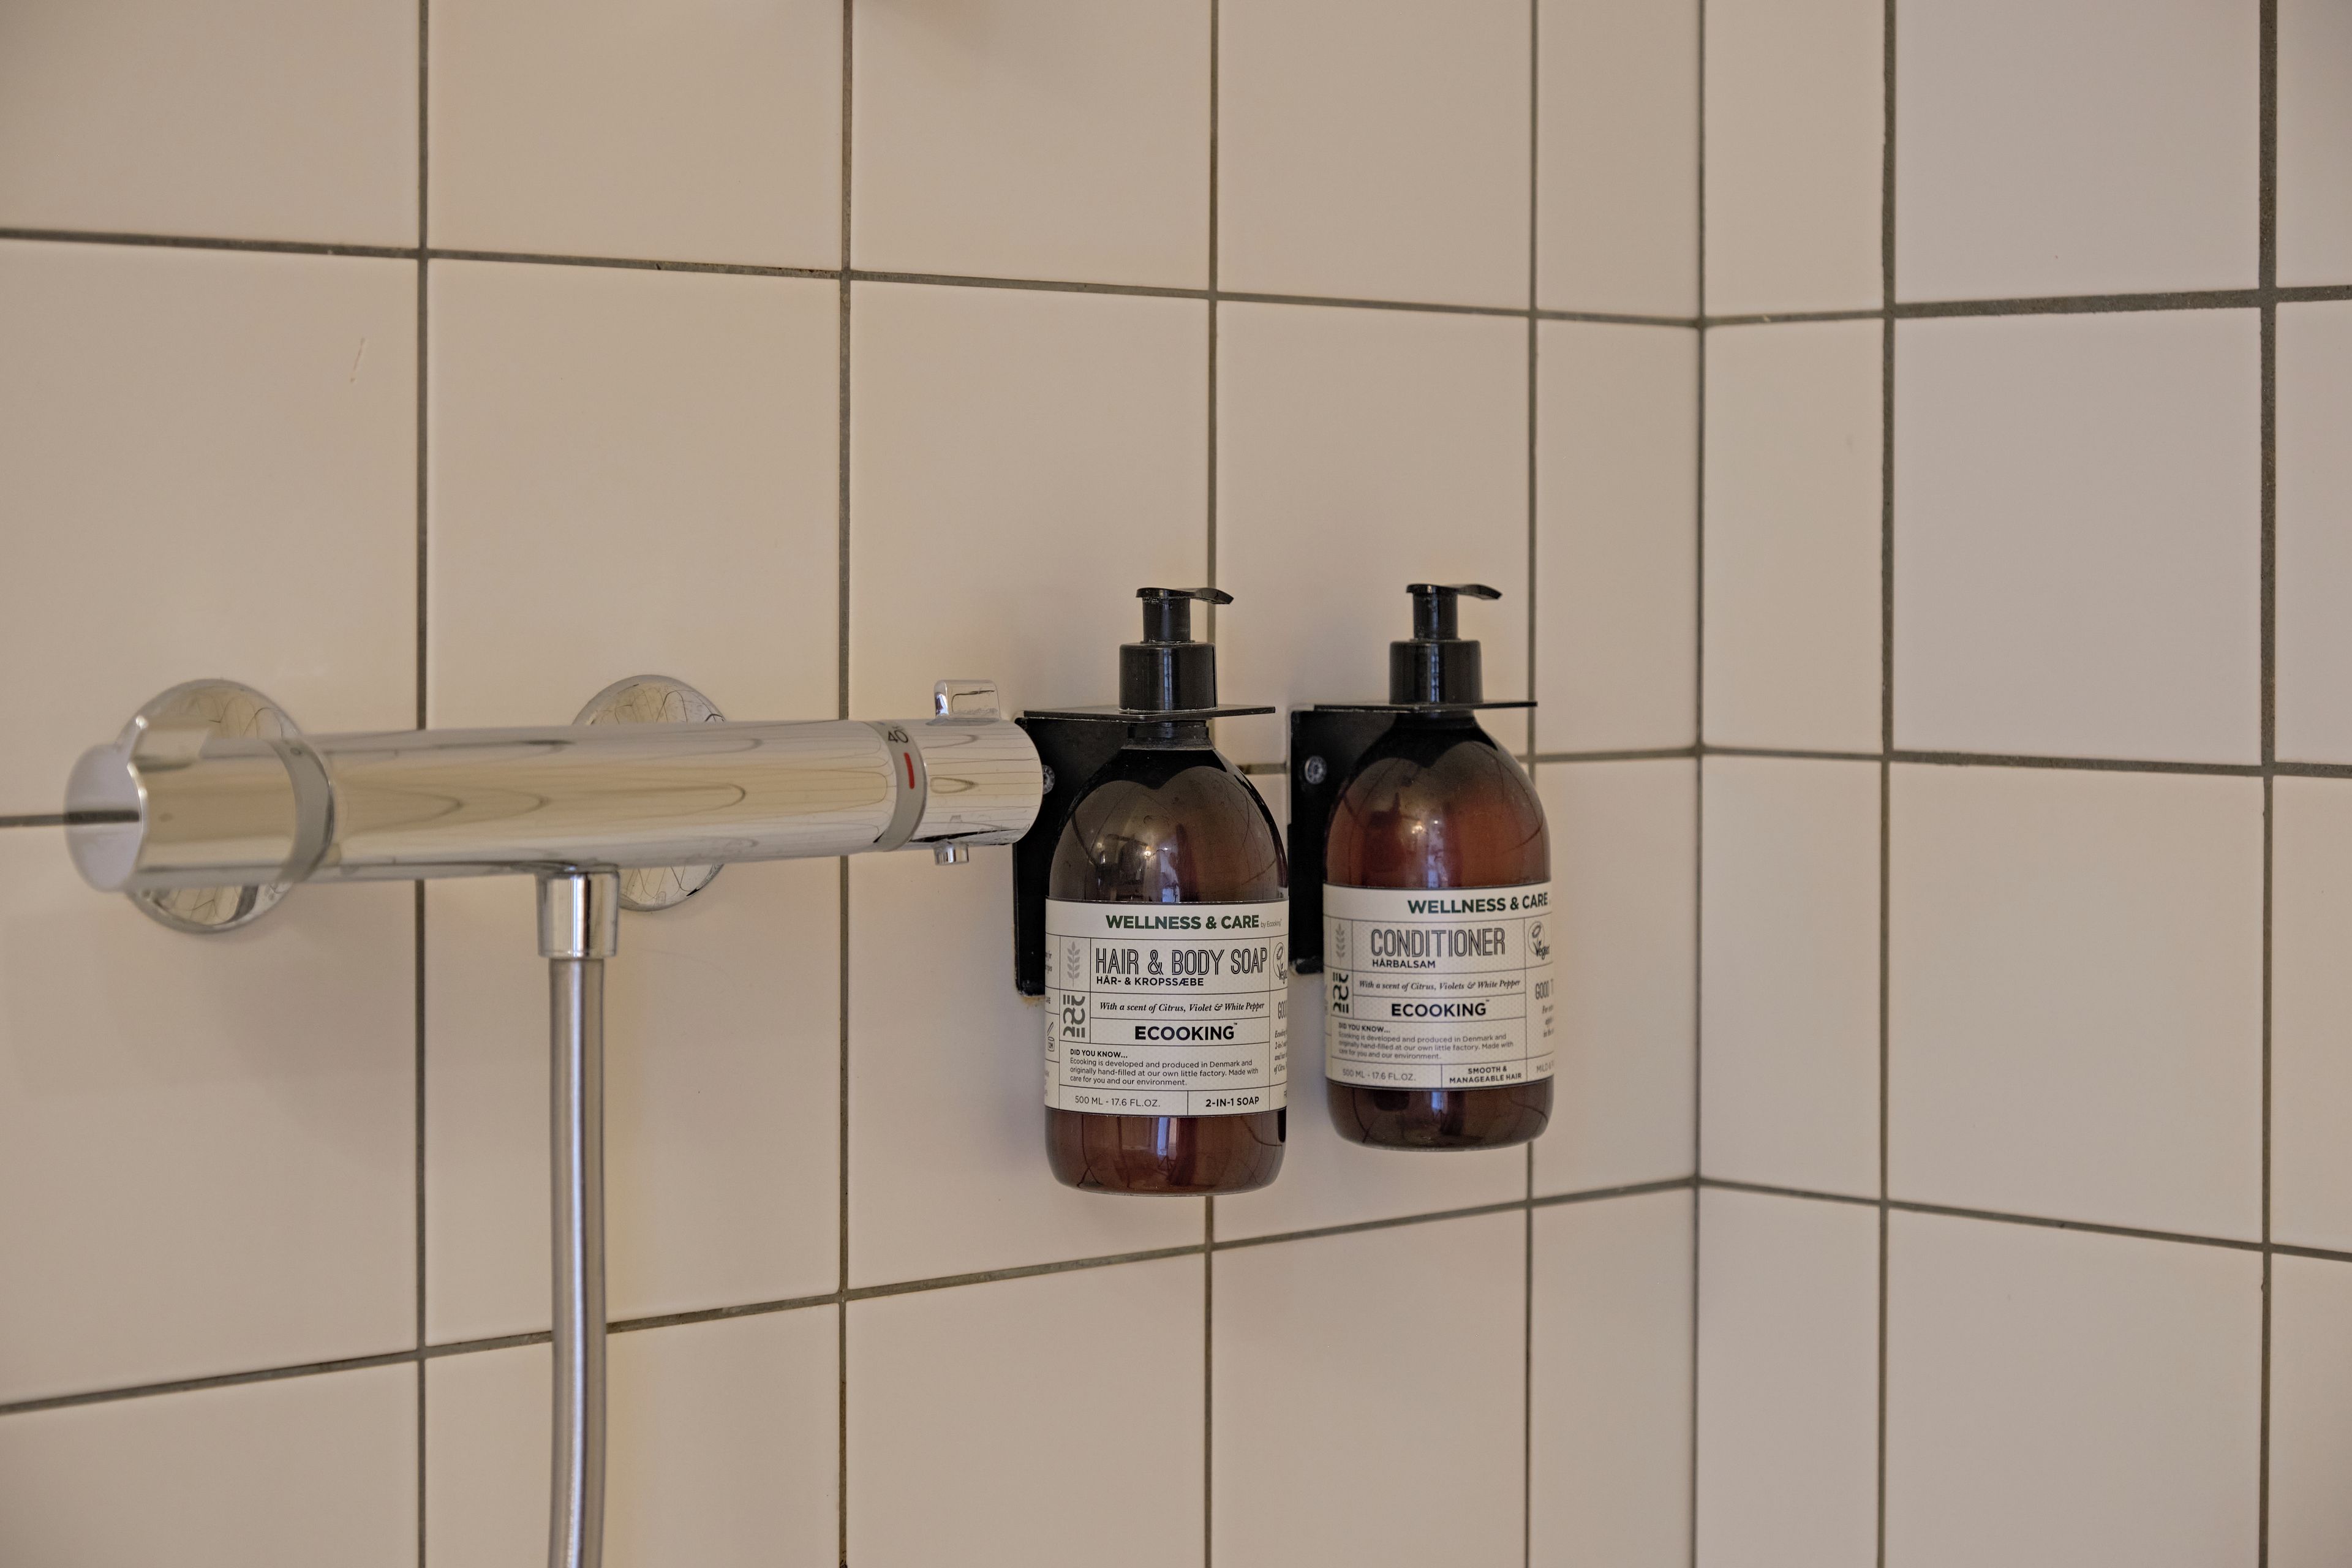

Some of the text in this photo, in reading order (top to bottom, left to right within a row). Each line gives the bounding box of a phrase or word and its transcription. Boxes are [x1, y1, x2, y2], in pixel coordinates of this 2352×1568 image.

[888, 729, 908, 744] 40
[1408, 892, 1548, 914] WELLNESS & CARE
[1106, 914, 1202, 930] WELLNESS
[1205, 916, 1217, 929] &
[1221, 914, 1259, 929] CARE
[1371, 928, 1506, 957] CONDITIONER
[1096, 948, 1268, 976] HAIR & BODY SOAP
[1372, 958, 1436, 968] HÅRBALSAM
[1096, 974, 1204, 986] HÅR- & KROPSSÆBE
[1359, 980, 1374, 989] With
[1401, 982, 1410, 992] of
[1410, 982, 1436, 990] Citrus,
[1499, 979, 1521, 989] Pepper
[1100, 1002, 1117, 1011] With
[1148, 1003, 1158, 1014] of
[1158, 1003, 1186, 1013] Citrus,
[1224, 1003, 1245, 1011] White
[1245, 1002, 1265, 1012] Pepper
[1368, 1034, 1401, 1043] developed
[1463, 1034, 1494, 1042] Denmark
[1360, 1042, 1394, 1050] hand-filled
[1070, 1058, 1096, 1068] Ecooking
[1070, 1067, 1096, 1077] originally
[1342, 1068, 1354, 1077] 500
[1355, 1070, 1365, 1079] ML
[1372, 1071, 1386, 1080] 17.6
[1388, 1072, 1416, 1081] FL.OZ.
[1468, 1066, 1501, 1074] SMOOTH
[1449, 1074, 1504, 1084] MANAGEABLE
[1075, 1095, 1090, 1104] 500
[1111, 1098, 1127, 1106] 17.6
[1129, 1098, 1161, 1107] FL.OZ.
[1205, 1096, 1259, 1107] 2-IN-1 SOAP
